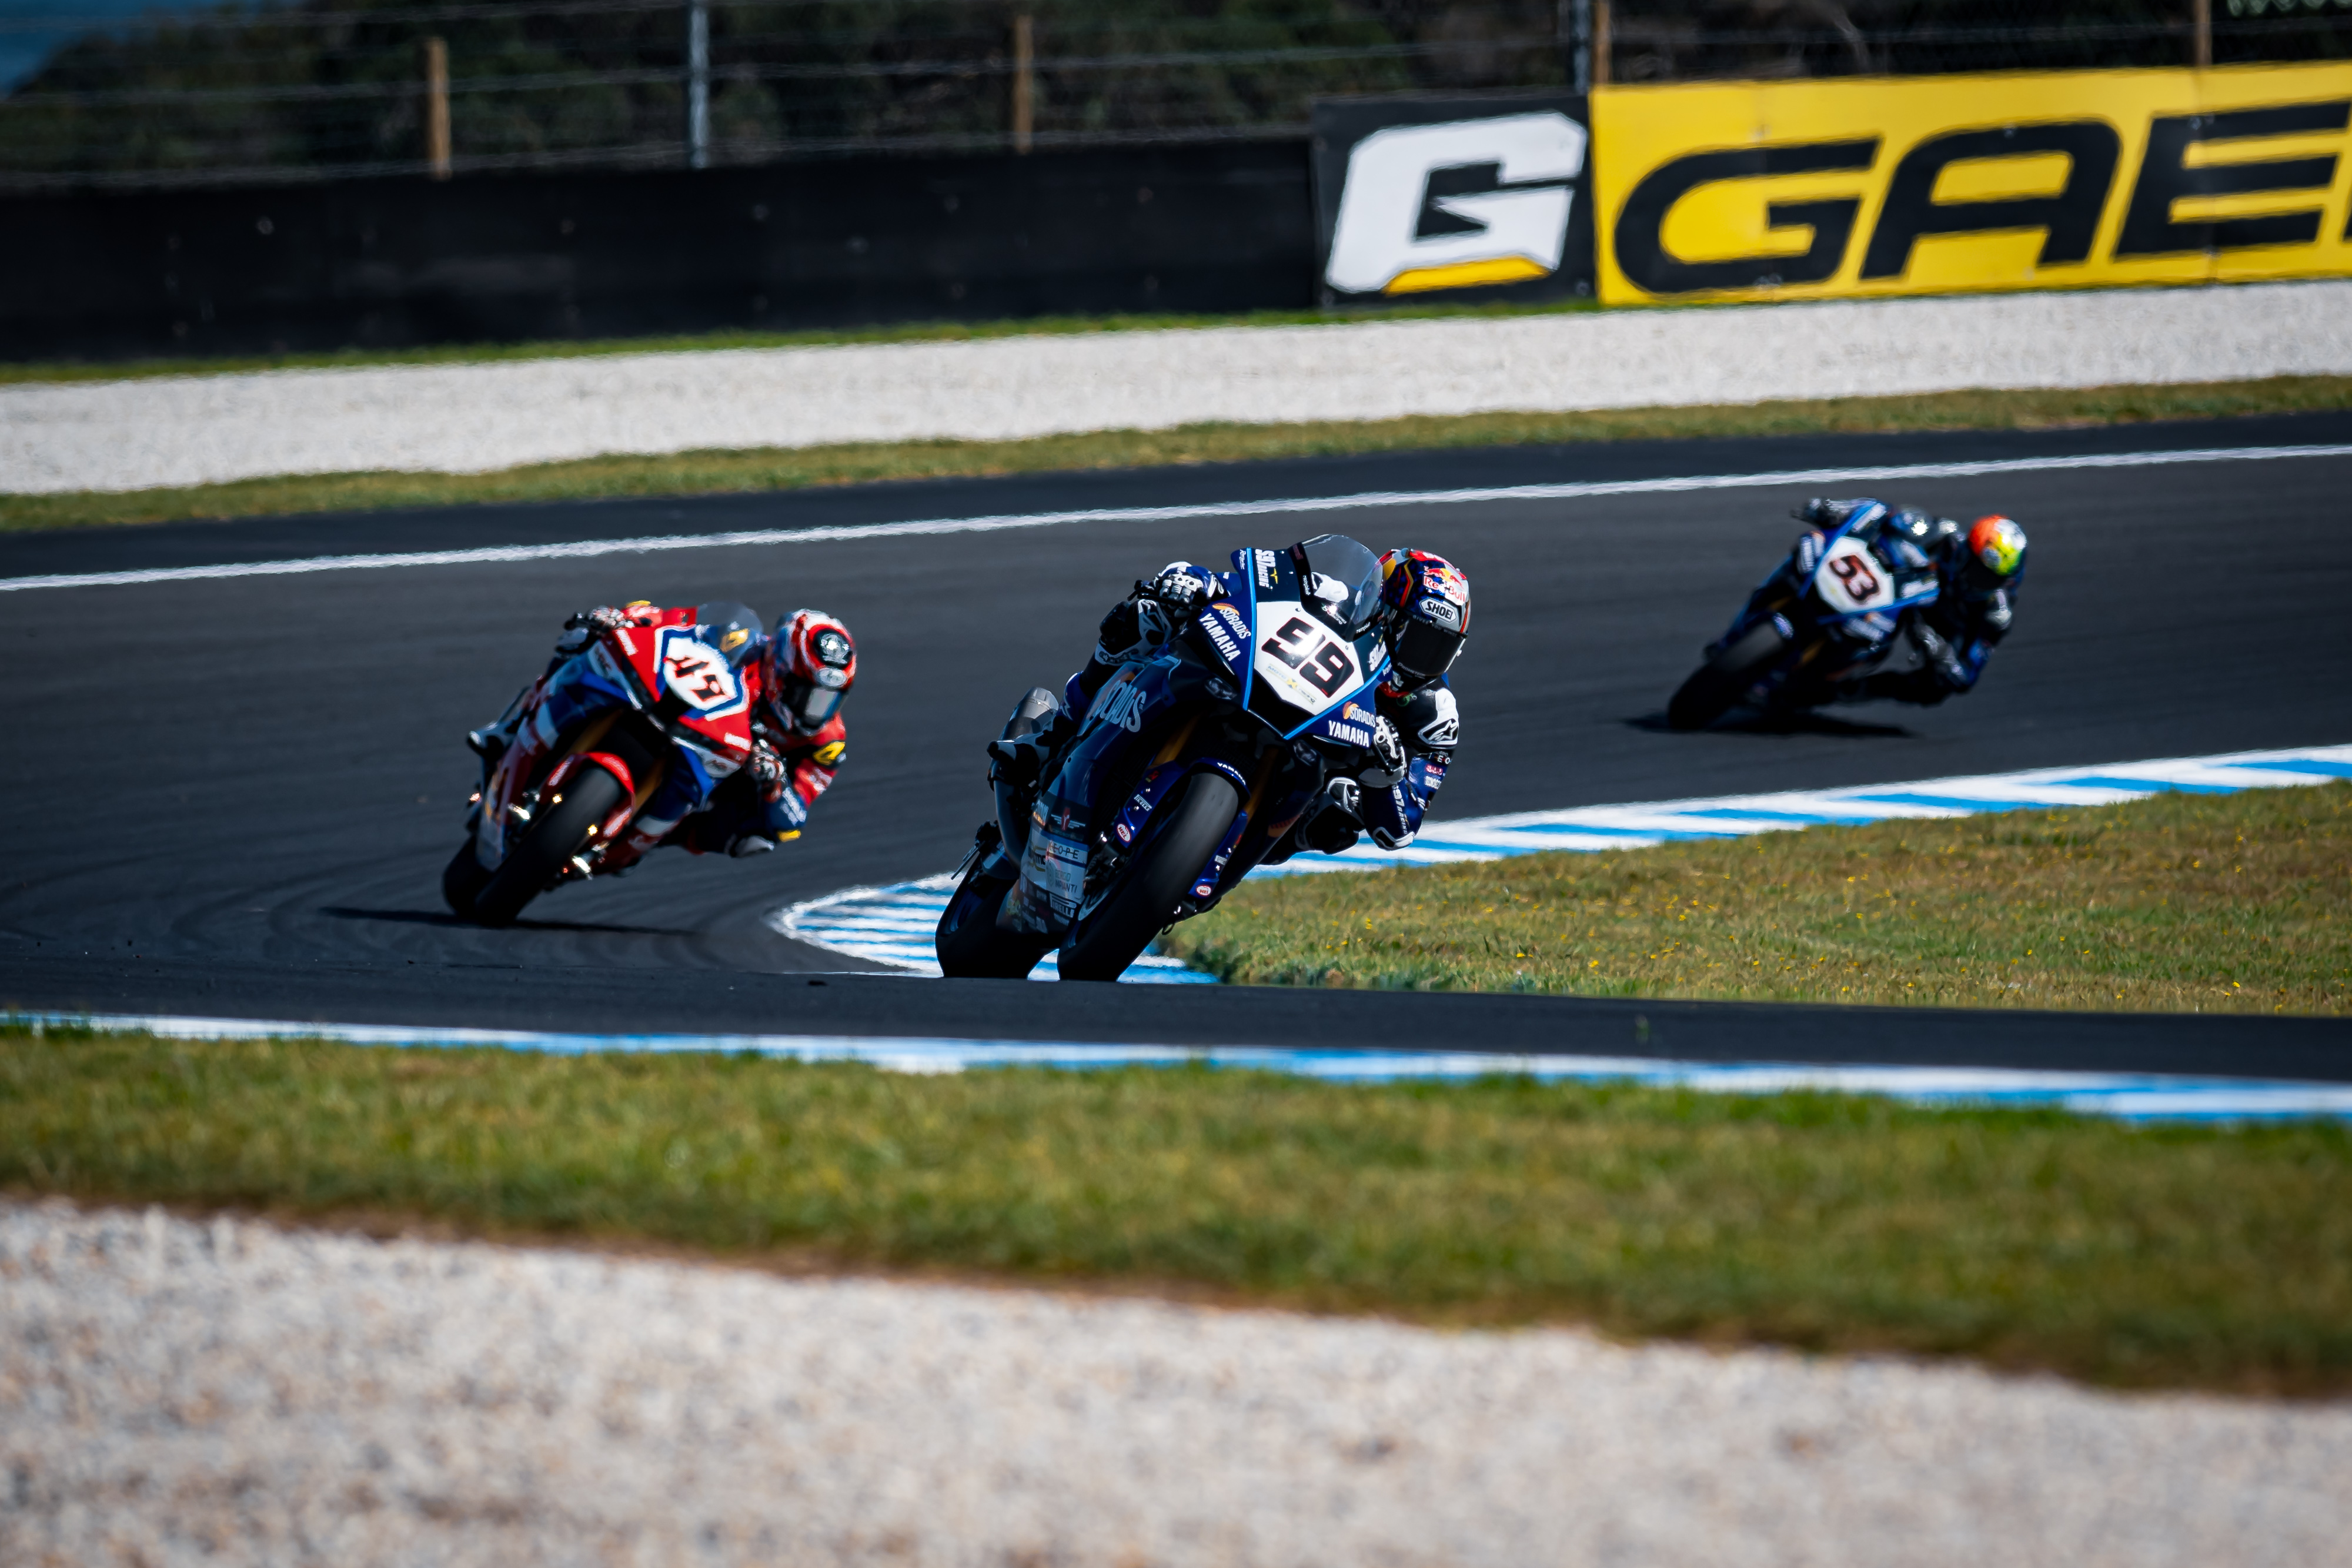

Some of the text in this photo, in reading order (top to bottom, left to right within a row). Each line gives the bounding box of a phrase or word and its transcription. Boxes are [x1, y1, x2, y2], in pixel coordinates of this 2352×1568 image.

[1614, 101, 2352, 293] GAE
[1448, 585, 1466, 603] Bull
[1828, 554, 1880, 603] 53
[1198, 613, 1241, 661] YAMAHA
[1261, 617, 1355, 698] 99
[1328, 720, 1369, 748] YAMAHA
